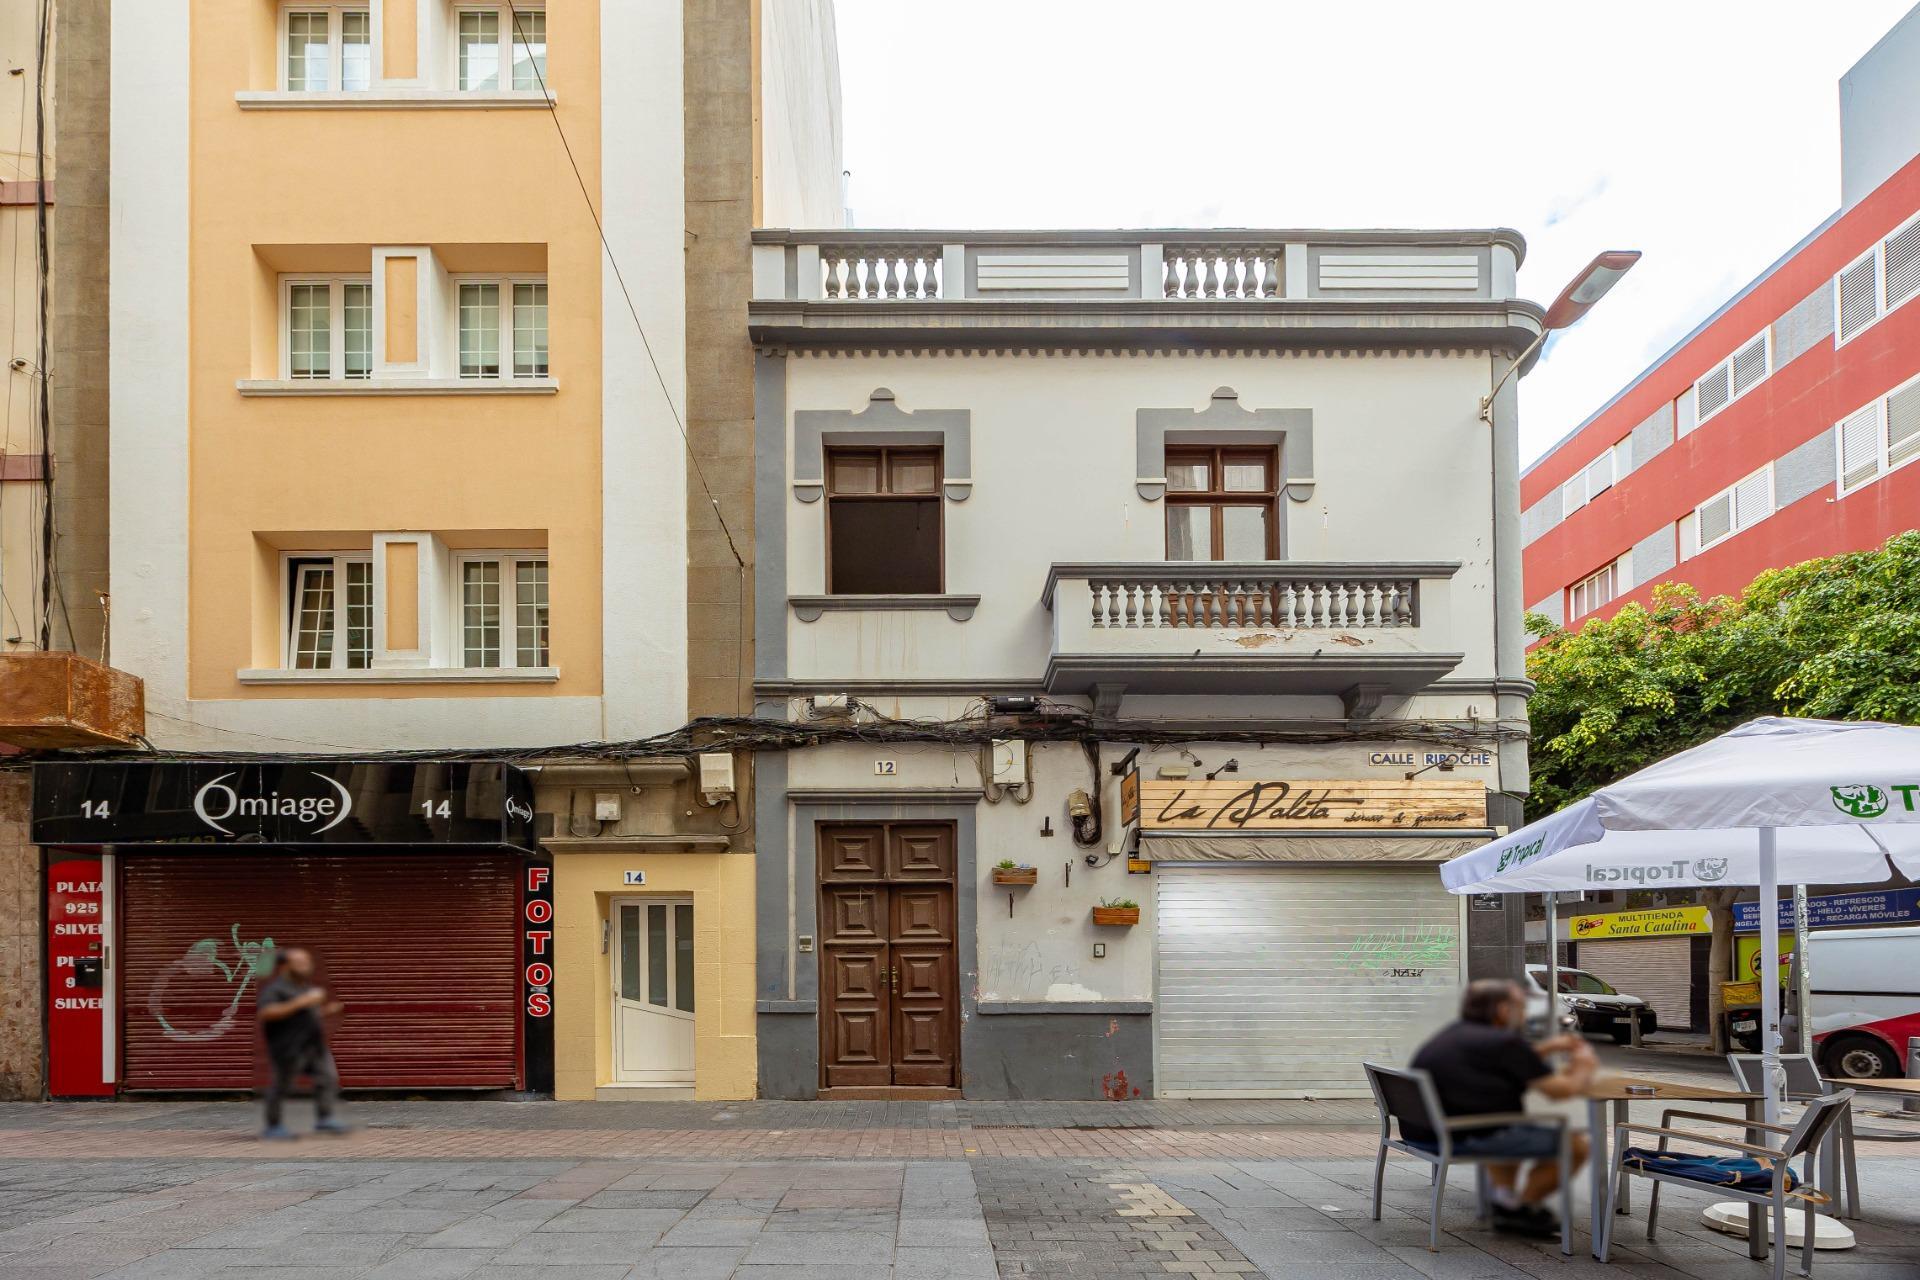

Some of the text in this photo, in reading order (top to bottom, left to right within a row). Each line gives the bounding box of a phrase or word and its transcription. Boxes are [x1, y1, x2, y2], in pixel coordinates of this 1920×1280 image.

[1371, 753, 1490, 765] CALLE RIPOCHE
[877, 761, 893, 773] 12
[81, 800, 110, 819] 14
[422, 799, 451, 819] 14
[1157, 789, 1207, 822] La
[1206, 781, 1365, 829] Paleta
[1511, 831, 1547, 864] Tropical
[626, 871, 644, 883] 14
[1833, 896, 1886, 906] REFRESCOS
[65, 902, 99, 914] 925
[1818, 907, 1842, 915] HIELO
[1848, 903, 1886, 912] VÍVERES
[1618, 911, 1684, 922] MULTITIENDA
[1826, 913, 1868, 921] RECARGA
[1869, 910, 1911, 919] MÓVILES
[1608, 923, 1640, 935] Santa
[1644, 920, 1697, 933] Catalina
[526, 867, 552, 1018] FOTOS
